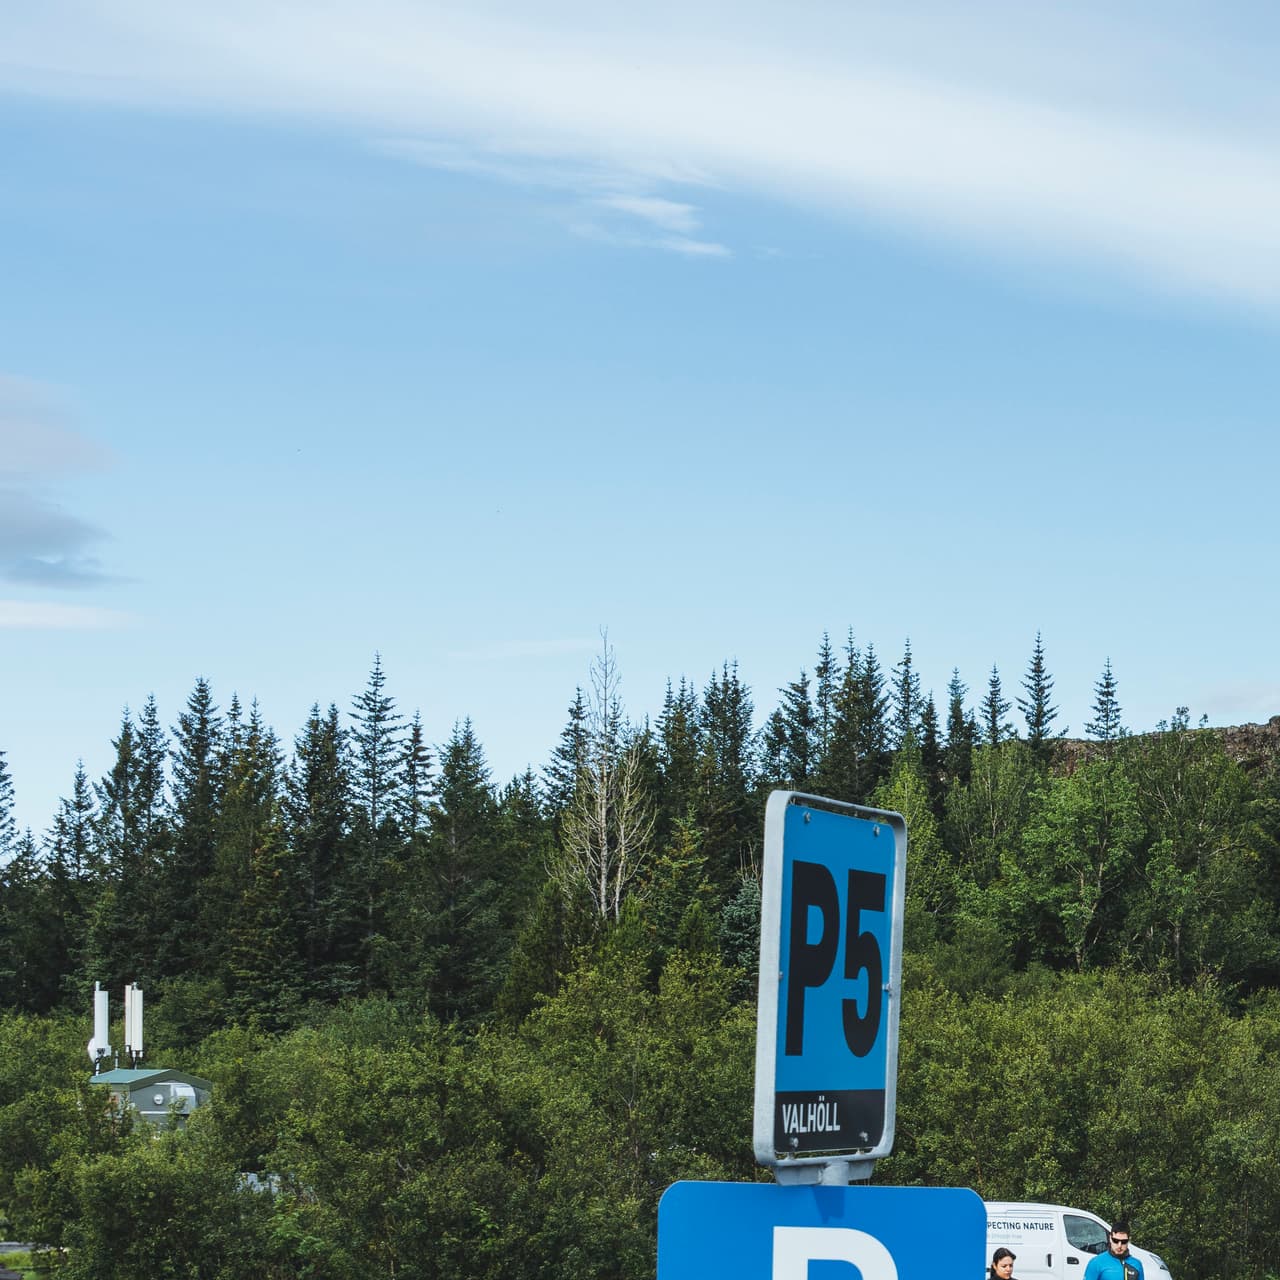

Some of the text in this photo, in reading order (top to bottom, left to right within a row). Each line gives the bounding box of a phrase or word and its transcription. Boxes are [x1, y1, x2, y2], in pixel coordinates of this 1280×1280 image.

[785, 860, 886, 1057] P5
[782, 1096, 840, 1134] VALHÖLL
[1023, 1222, 1054, 1231] NATURE
